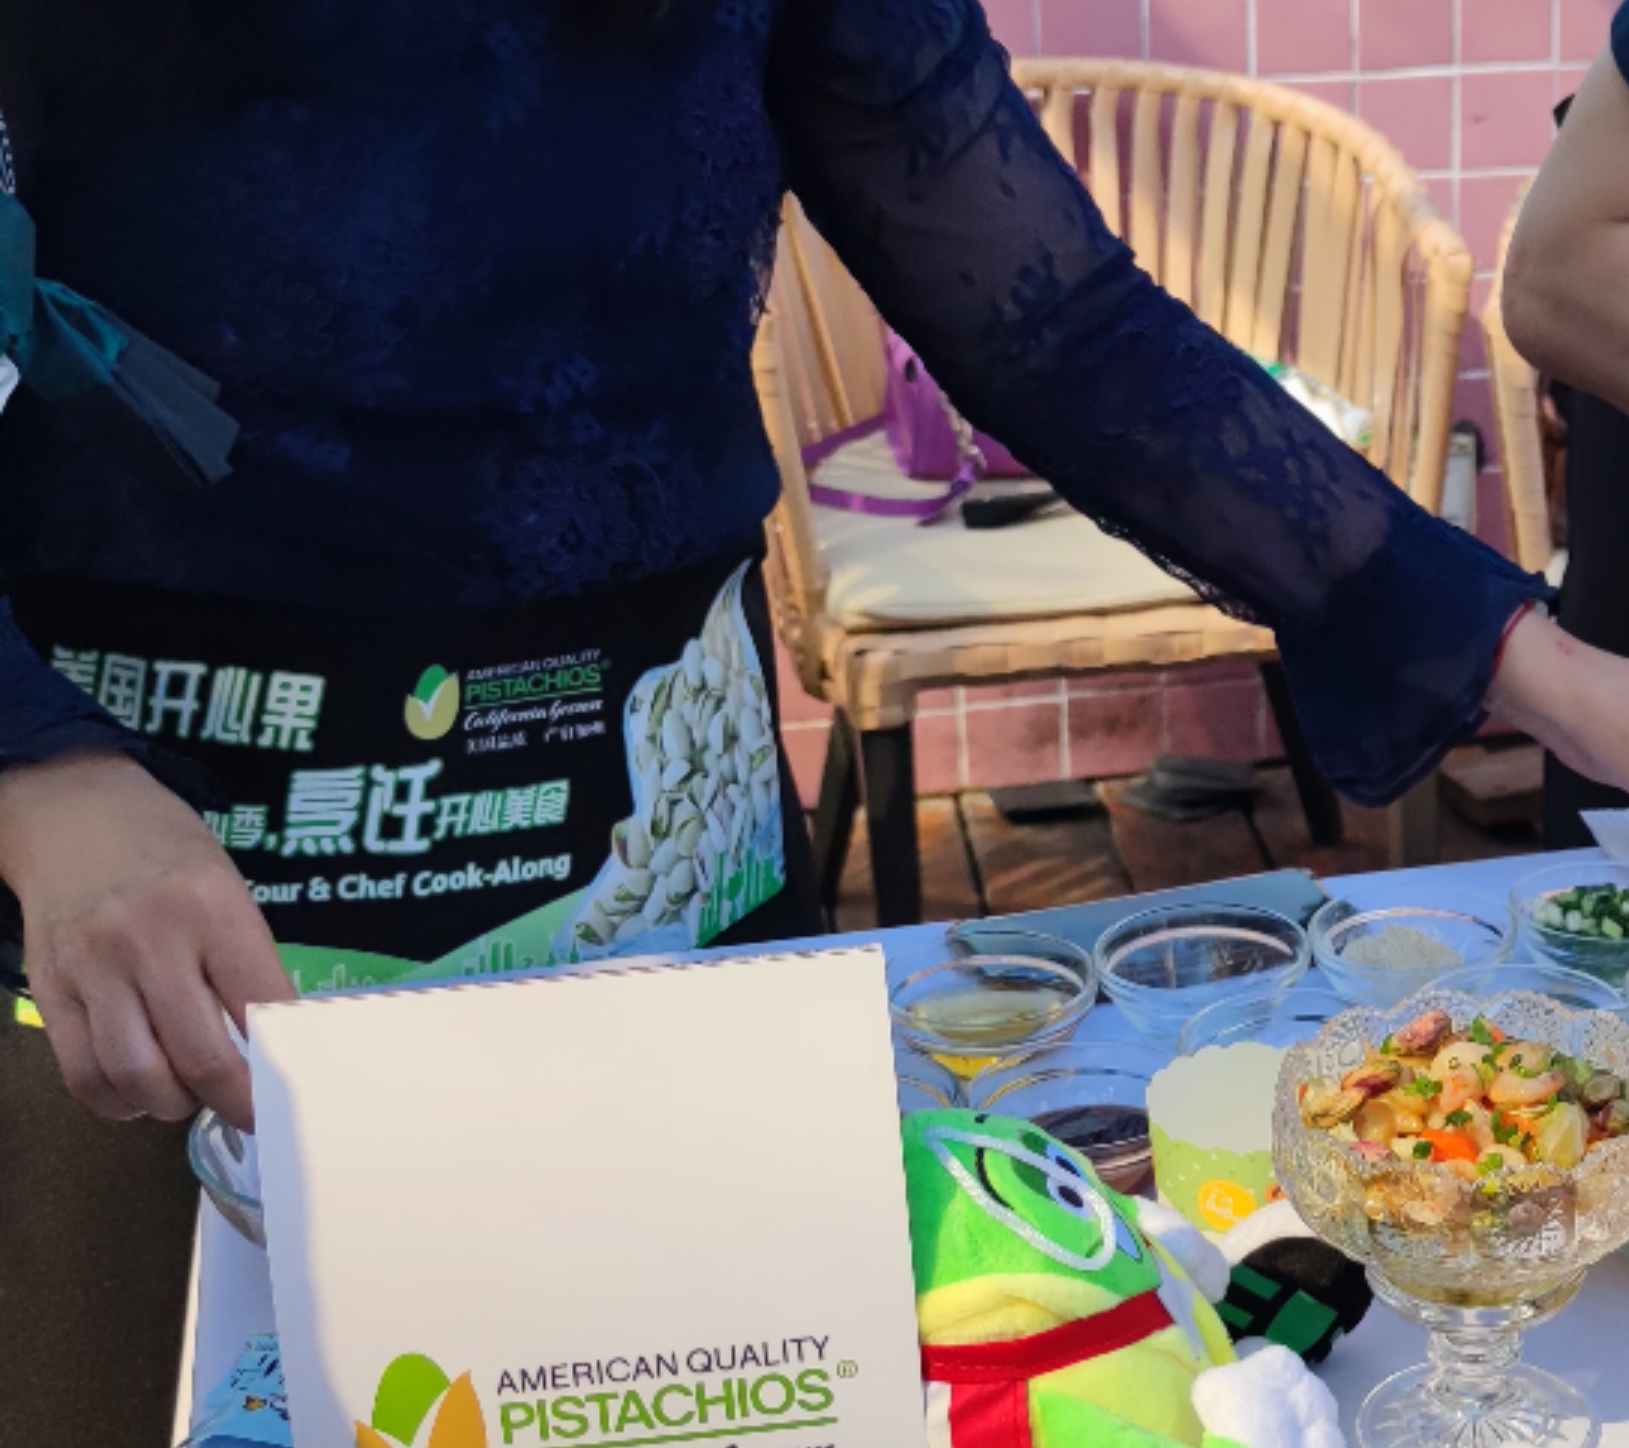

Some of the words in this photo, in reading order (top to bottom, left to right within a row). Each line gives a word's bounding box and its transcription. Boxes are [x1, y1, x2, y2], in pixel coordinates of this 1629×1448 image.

[308, 875, 333, 901] &
[337, 872, 405, 900] Chef
[412, 853, 572, 898] Cook-Along
[497, 1352, 679, 1395] AMERICAN
[685, 1334, 831, 1372] QUALITY
